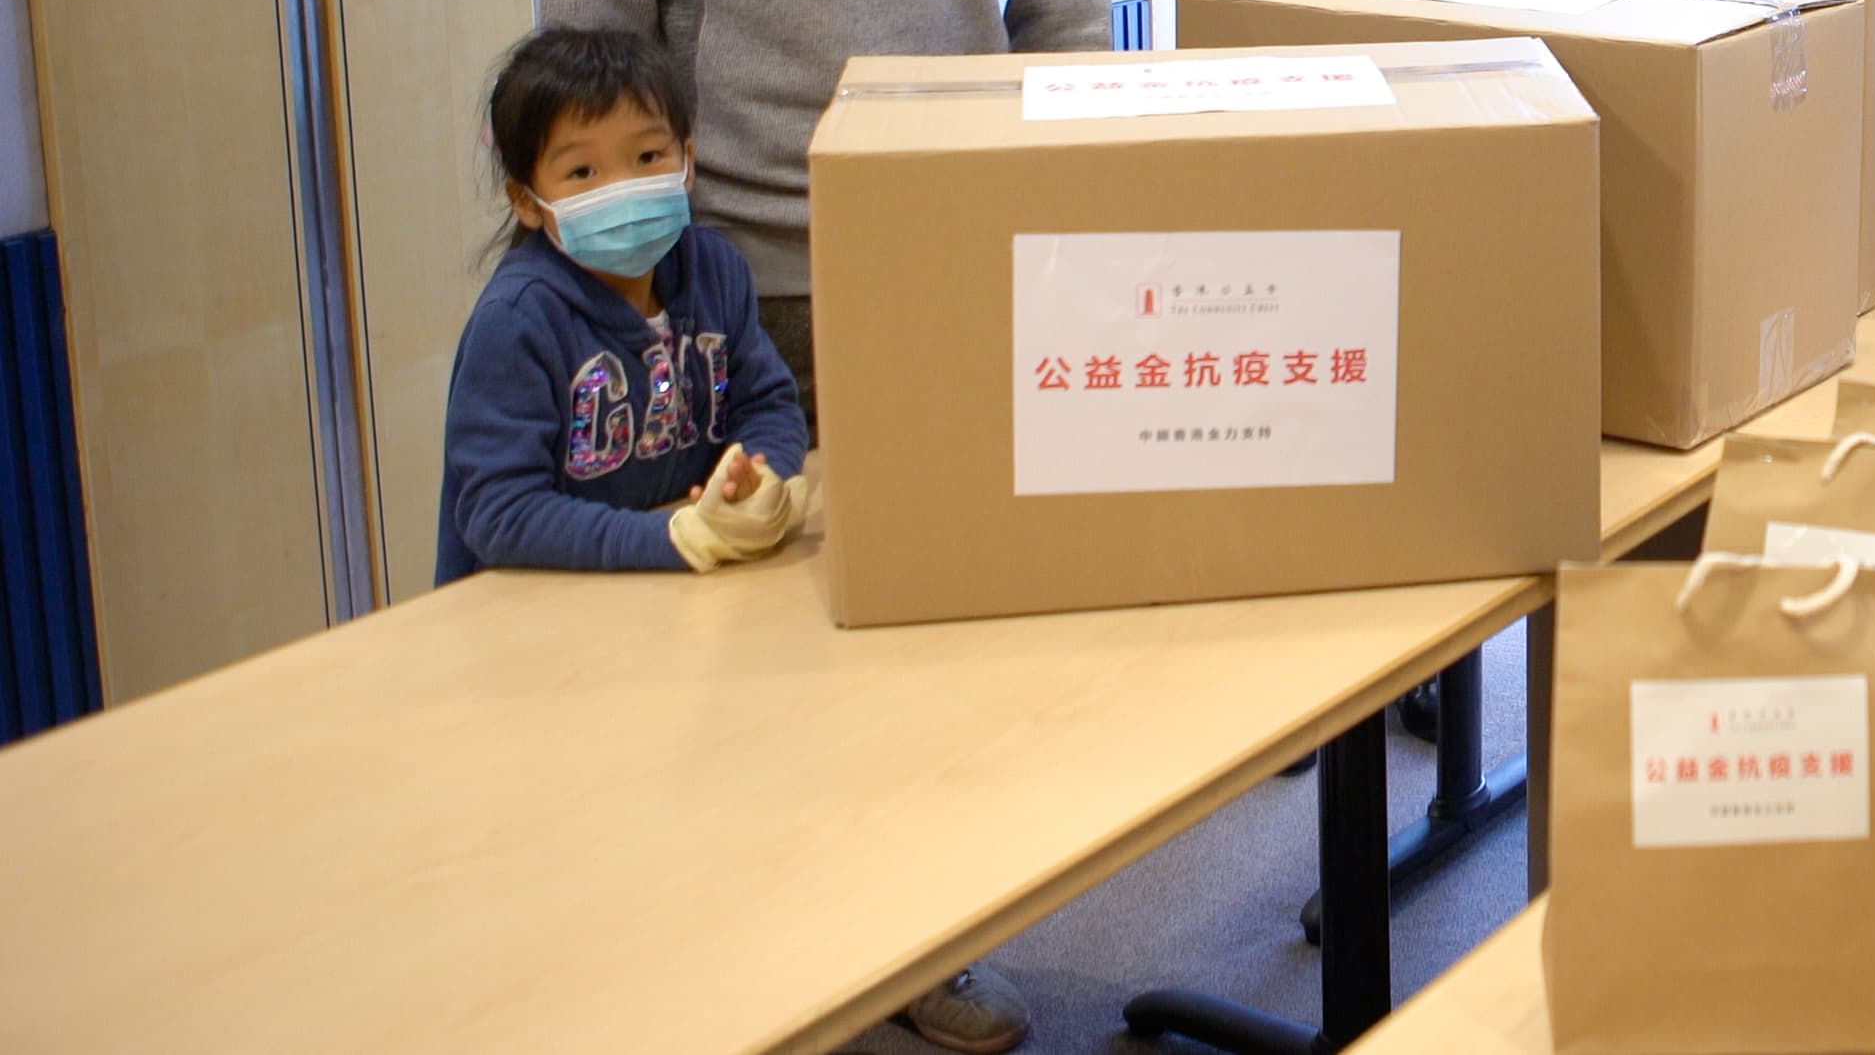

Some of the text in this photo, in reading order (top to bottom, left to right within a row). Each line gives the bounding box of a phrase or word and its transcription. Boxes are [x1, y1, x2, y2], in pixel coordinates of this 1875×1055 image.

[1035, 347, 1367, 391] 公益金抗疫支援
